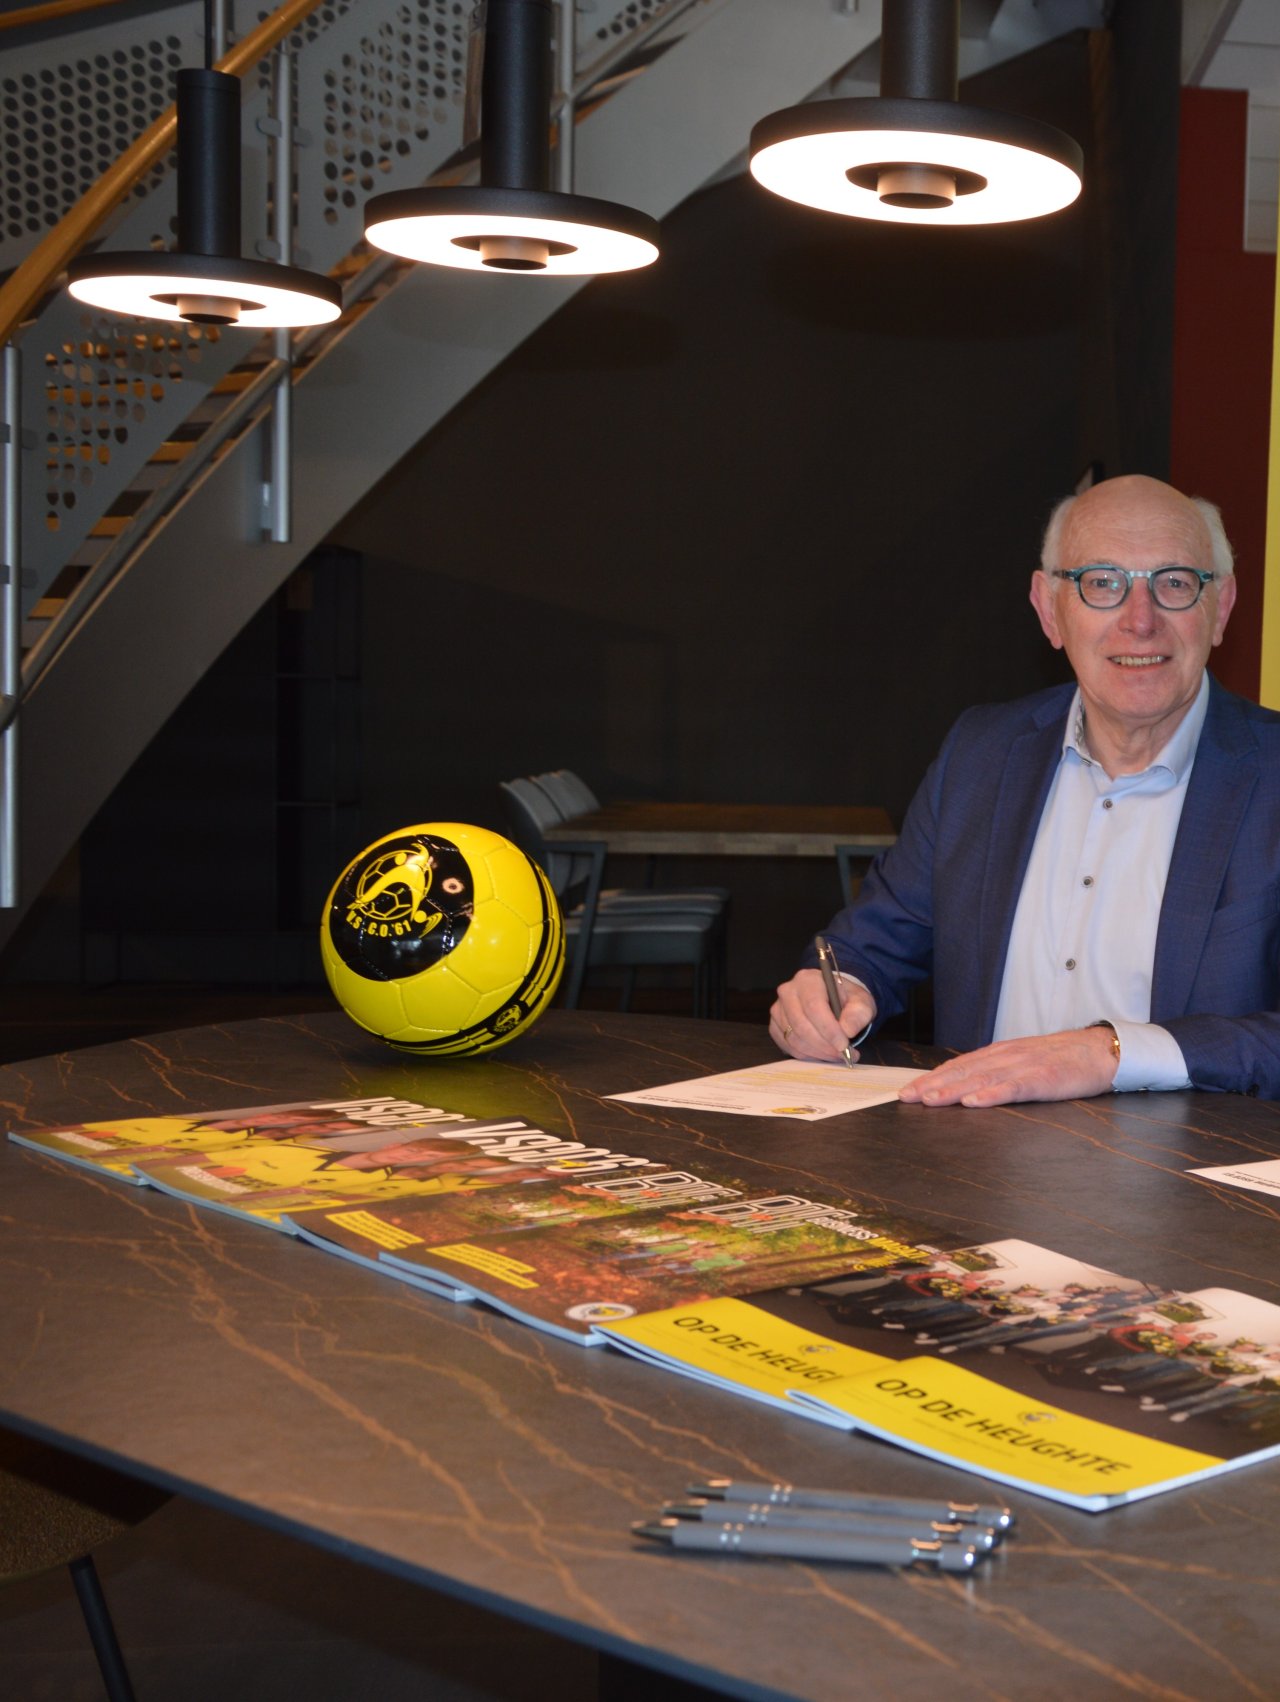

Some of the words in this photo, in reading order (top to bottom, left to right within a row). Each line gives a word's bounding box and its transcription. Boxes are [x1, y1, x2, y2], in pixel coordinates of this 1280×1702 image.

[673, 1316, 721, 1334] OP
[709, 1334, 761, 1352] DE
[747, 1349, 844, 1384] HEUG
[875, 1379, 929, 1399] OP
[919, 1399, 977, 1422] DE
[964, 1418, 1133, 1476] HEUGHTE
